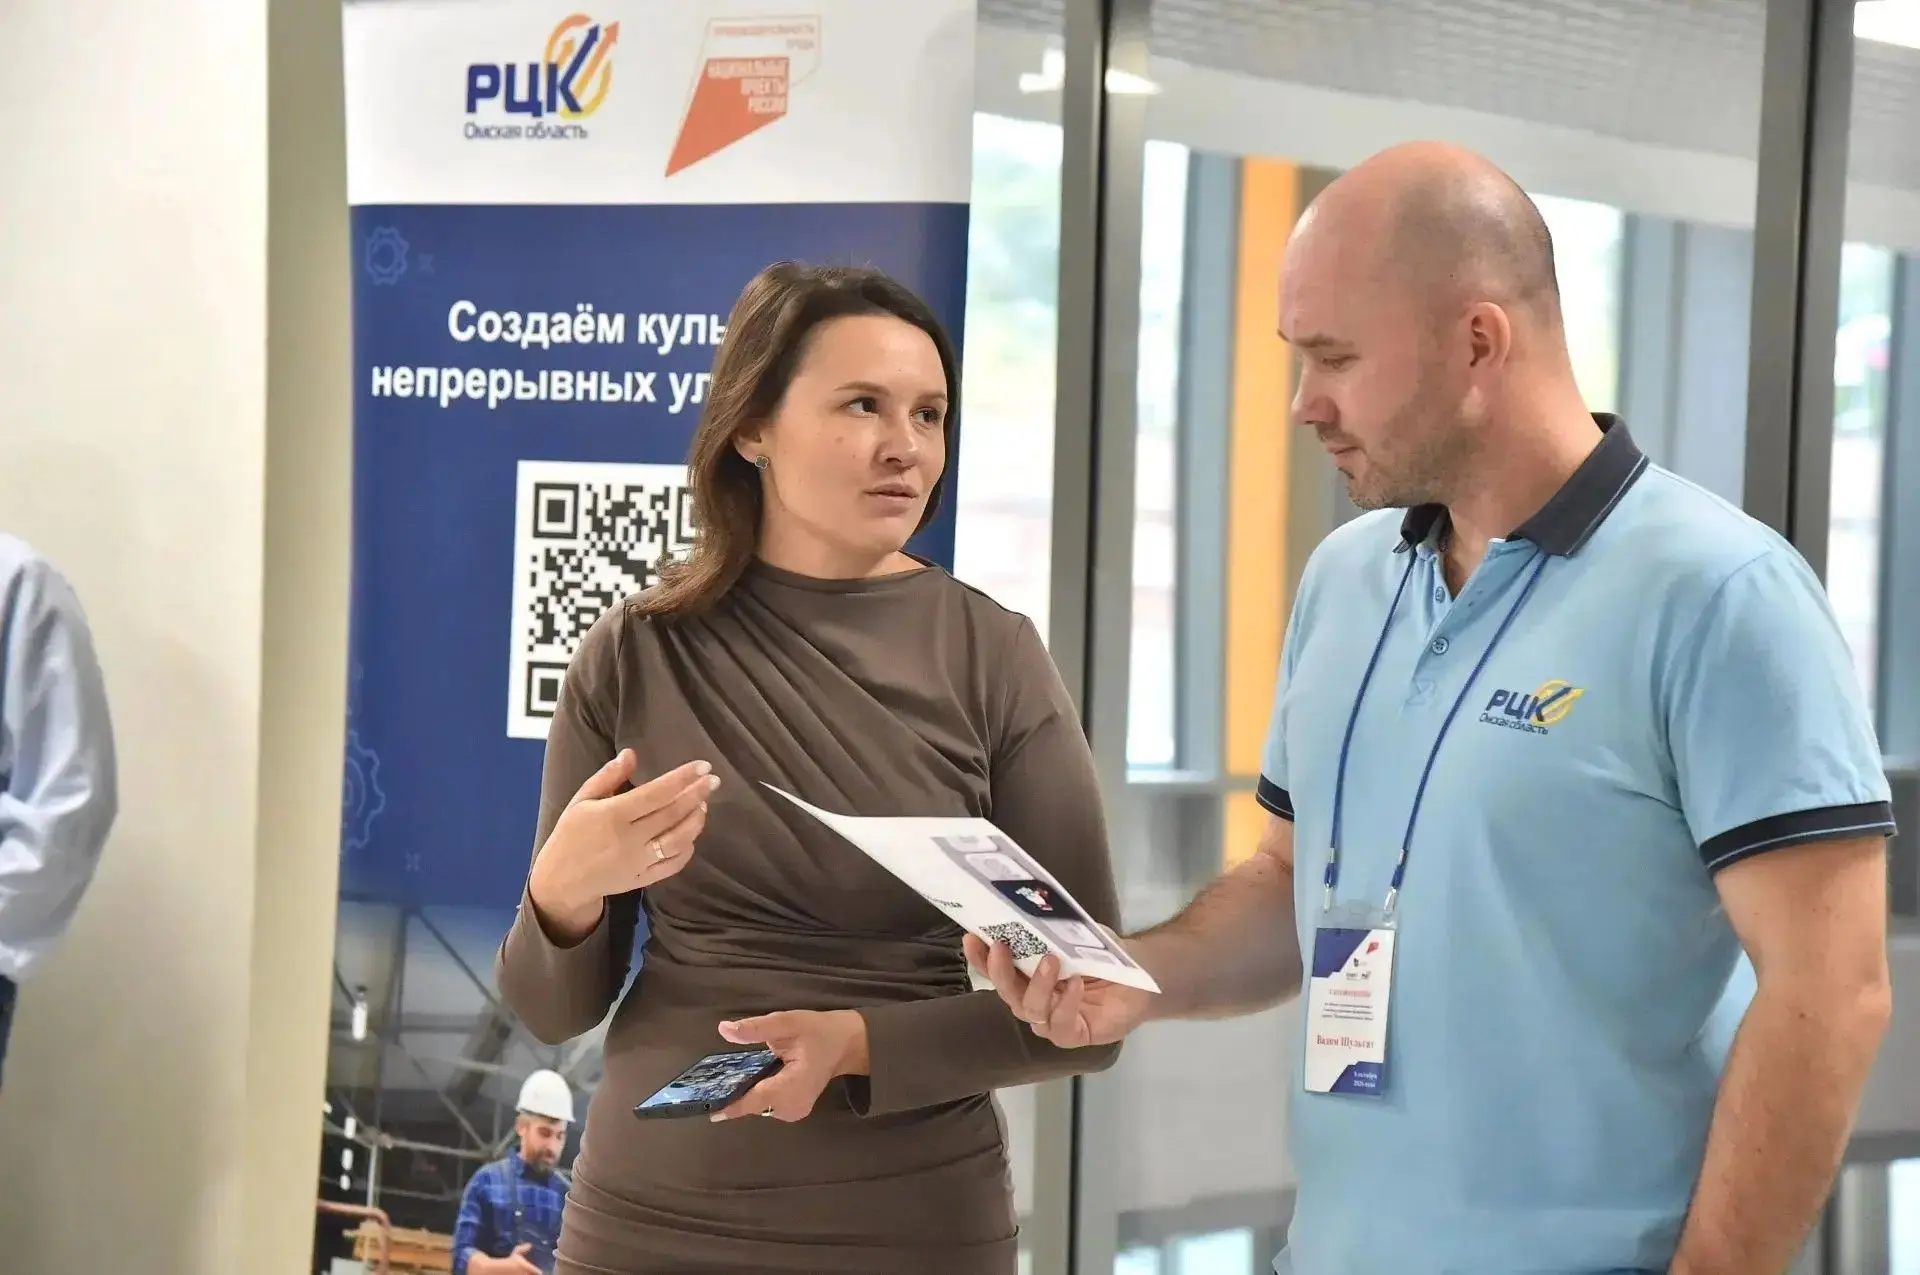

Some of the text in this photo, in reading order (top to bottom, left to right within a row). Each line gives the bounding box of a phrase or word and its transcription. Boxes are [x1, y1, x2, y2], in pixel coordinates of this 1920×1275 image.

[466, 24, 600, 118] РЦК
[463, 121, 588, 140] Омская область
[448, 299, 625, 350] Создаём
[371, 365, 657, 410] непрерывных
[1485, 687, 1573, 722] РЦК
